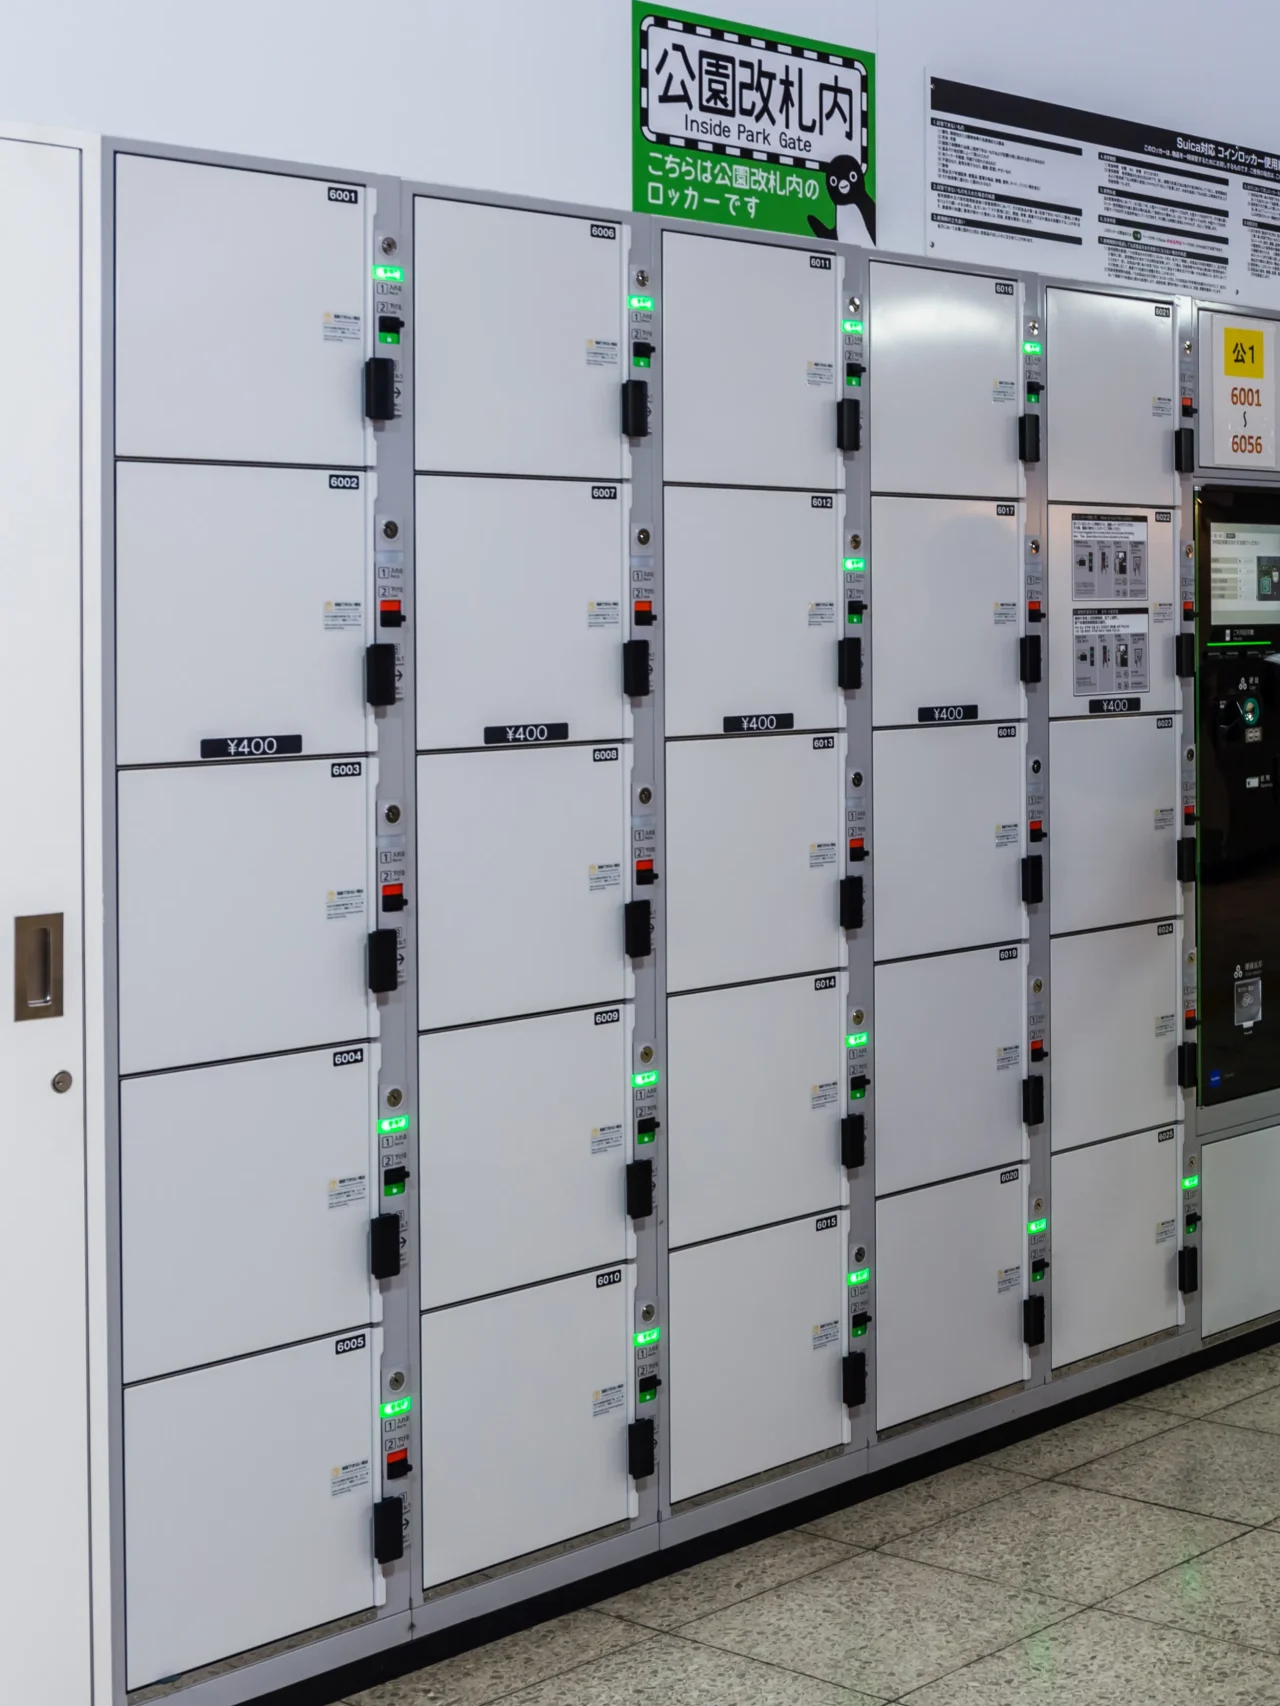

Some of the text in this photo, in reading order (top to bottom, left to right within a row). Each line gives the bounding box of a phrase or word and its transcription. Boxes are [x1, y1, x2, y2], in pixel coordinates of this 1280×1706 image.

[655, 42, 853, 141] 公園改札内
[685, 114, 812, 153] Inside Park Gate
[1176, 137, 1216, 157] Suica対応
[648, 151, 819, 200] こちらは公園改札内の
[330, 189, 356, 202] 6001
[648, 182, 760, 219] ロッカーです
[592, 226, 614, 238] 6006
[812, 258, 829, 268] 6011
[996, 283, 1012, 294] 6016
[1156, 307, 1169, 317] 6021
[1232, 342, 1255, 364] 公1
[1231, 387, 1262, 407] 6001
[1231, 435, 1263, 454] 6056
[331, 476, 357, 488] 6002
[594, 488, 615, 497] 6007
[814, 498, 830, 506] 6012
[998, 505, 1013, 515] 6017
[1156, 513, 1170, 521] 6022
[1102, 700, 1128, 712] ¥400
[934, 707, 963, 720] ¥400
[742, 716, 776, 730] ¥400
[1158, 718, 1171, 728] 6023
[506, 726, 547, 741] ¥400
[999, 727, 1015, 737] 6018
[228, 738, 276, 755] ¥400
[815, 738, 832, 748] 6013
[595, 750, 616, 760] 6008
[333, 764, 359, 775] 6003
[1158, 924, 1172, 935] 6024
[1000, 949, 1017, 960] 6019
[816, 978, 834, 988] 6014
[596, 1011, 617, 1023] 6009
[335, 1050, 361, 1064] 6004
[1159, 1129, 1173, 1141] 6025
[1001, 1169, 1017, 1183] 6020
[818, 1217, 835, 1229] 6015
[598, 1272, 619, 1286] 6010
[338, 1336, 364, 1352] 6005
